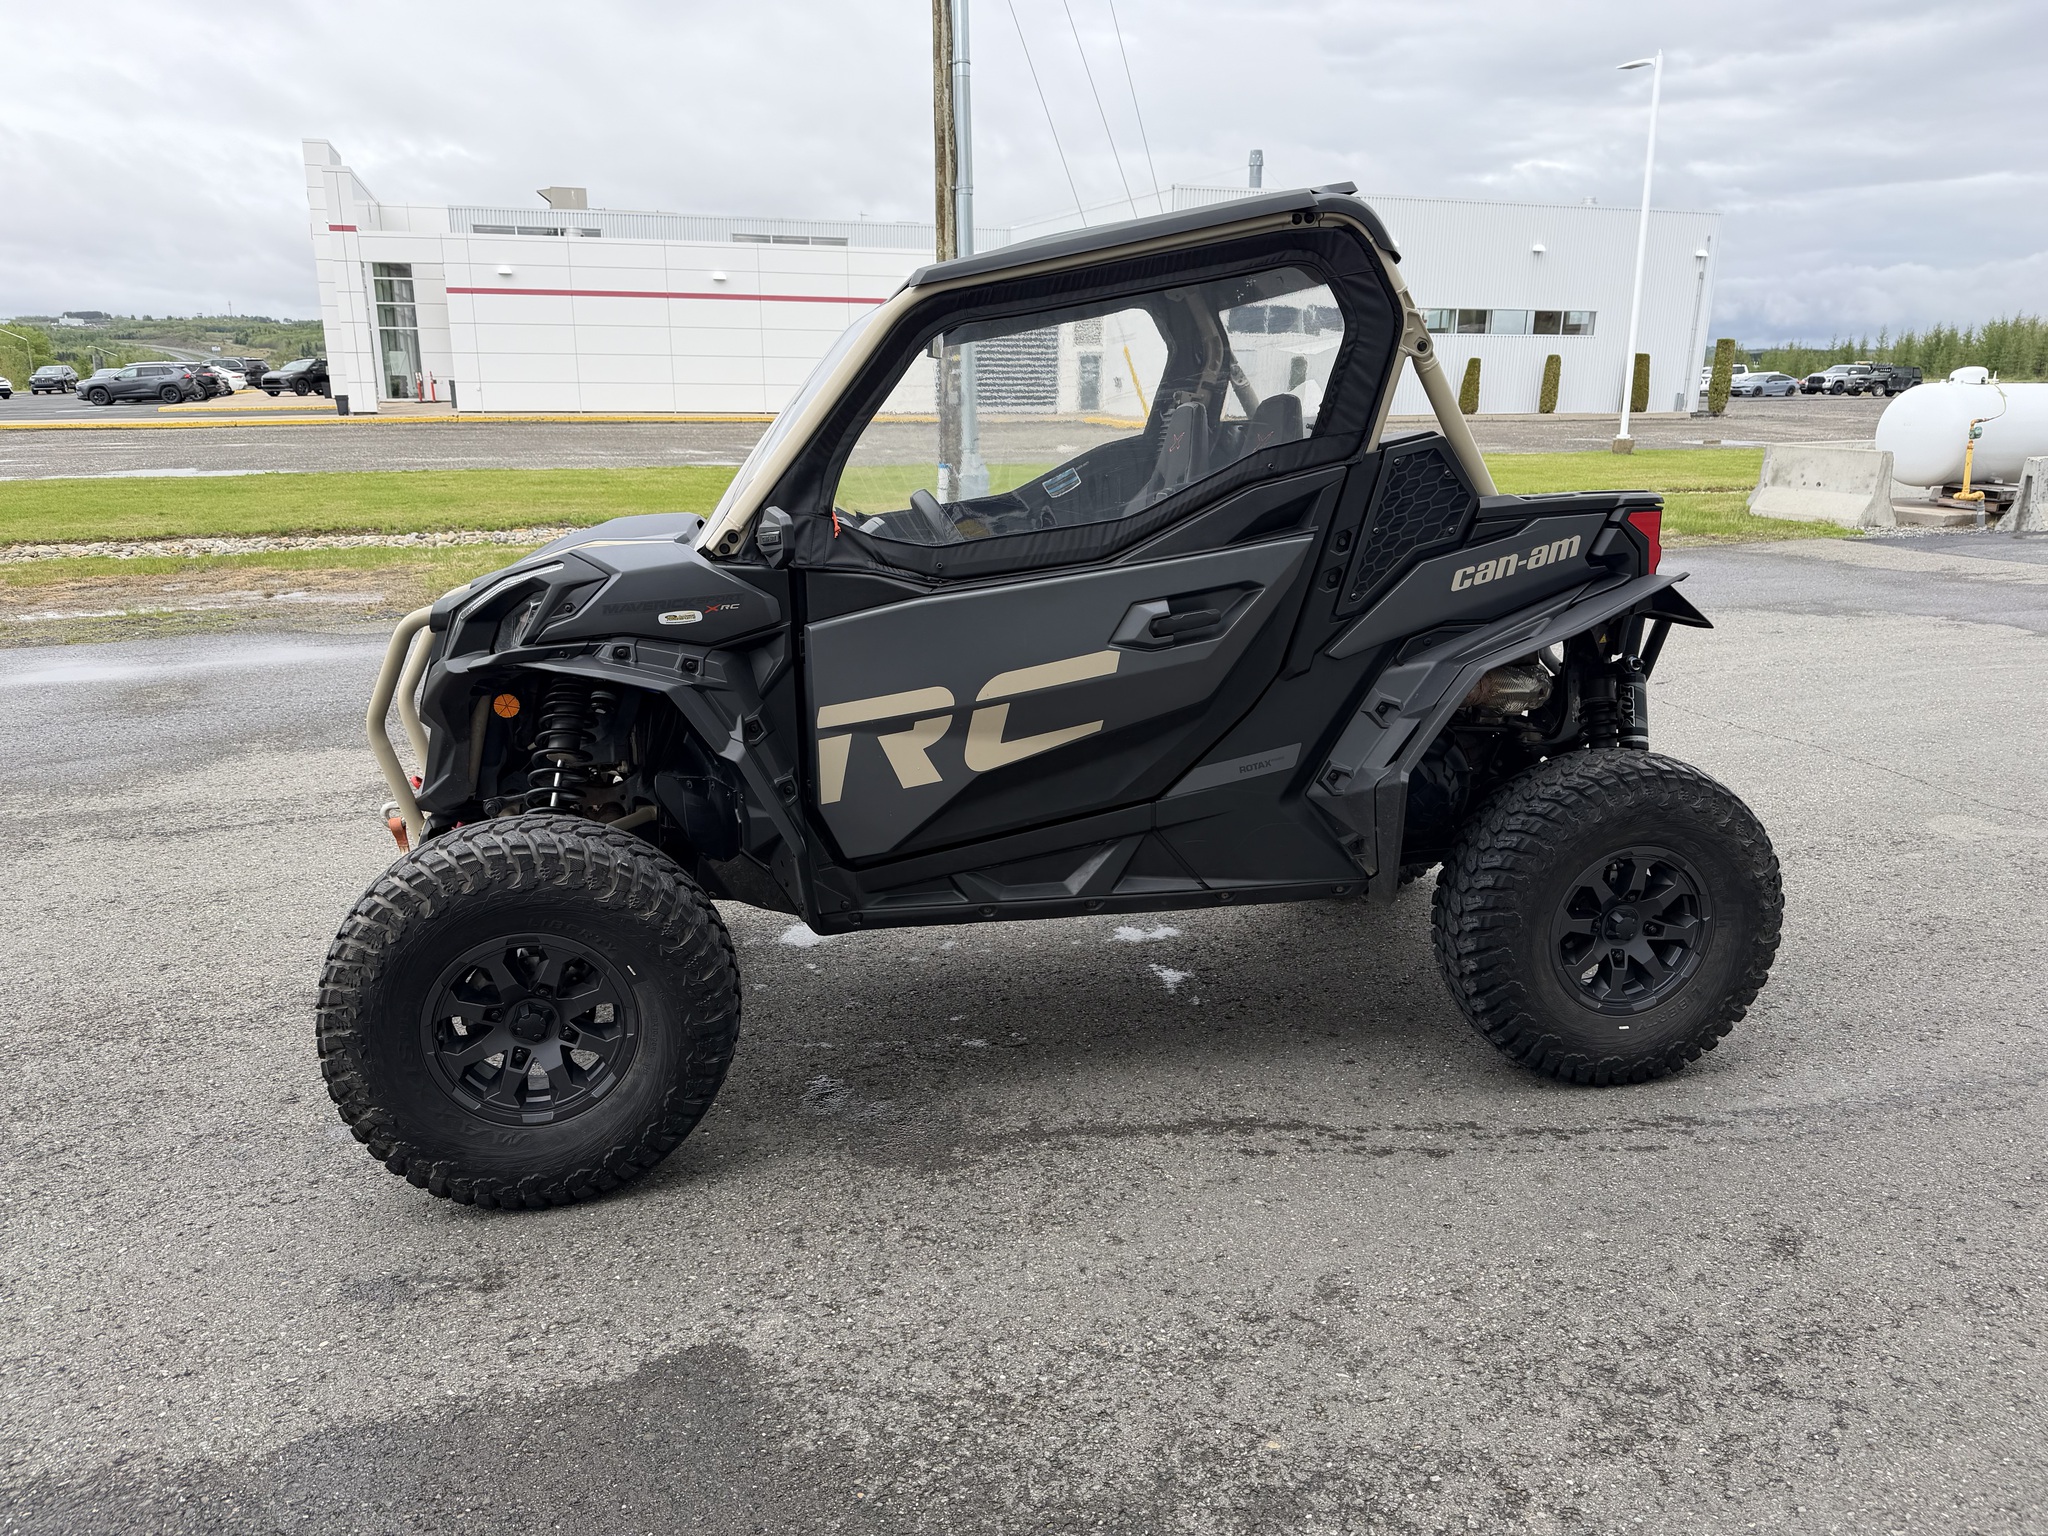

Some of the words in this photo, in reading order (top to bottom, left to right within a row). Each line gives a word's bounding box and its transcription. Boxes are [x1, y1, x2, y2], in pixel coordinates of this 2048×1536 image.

[1450, 534, 1582, 593] can-am
[816, 650, 1121, 805] RC
[1618, 683, 1636, 728] FOX
[1239, 759, 1272, 774] ROTAX
